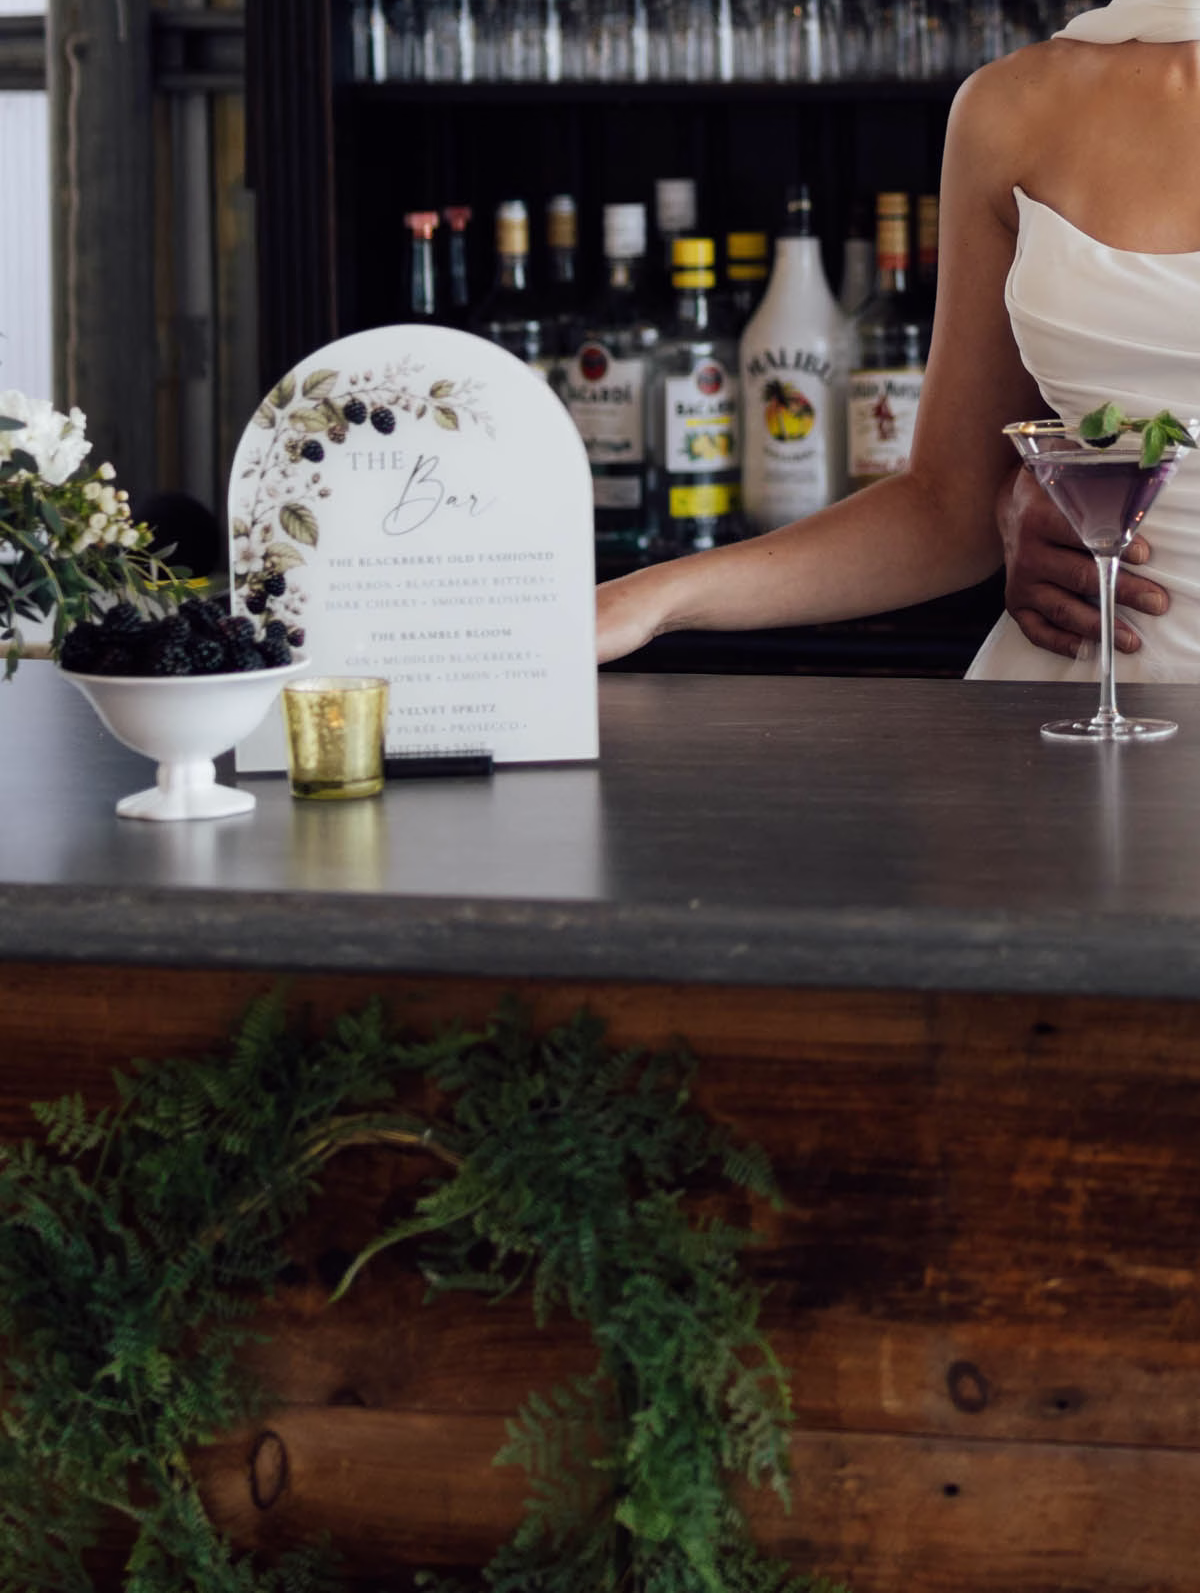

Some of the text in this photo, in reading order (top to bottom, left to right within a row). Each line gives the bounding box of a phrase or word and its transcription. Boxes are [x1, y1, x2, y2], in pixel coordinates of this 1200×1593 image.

[748, 347, 833, 386] MALIBU
[345, 450, 405, 472] THE
[382, 454, 497, 536] Bar
[328, 550, 555, 568] THE BLACKBERRY OLD FASHIONED
[370, 628, 512, 642] THE BRAMBLE BLOOM
[446, 671, 491, 683] LEMON
[503, 668, 548, 680] THYME
[398, 704, 446, 716] VELVET
[451, 702, 496, 714] SPRITZ
[449, 719, 521, 734] PROSECCO
